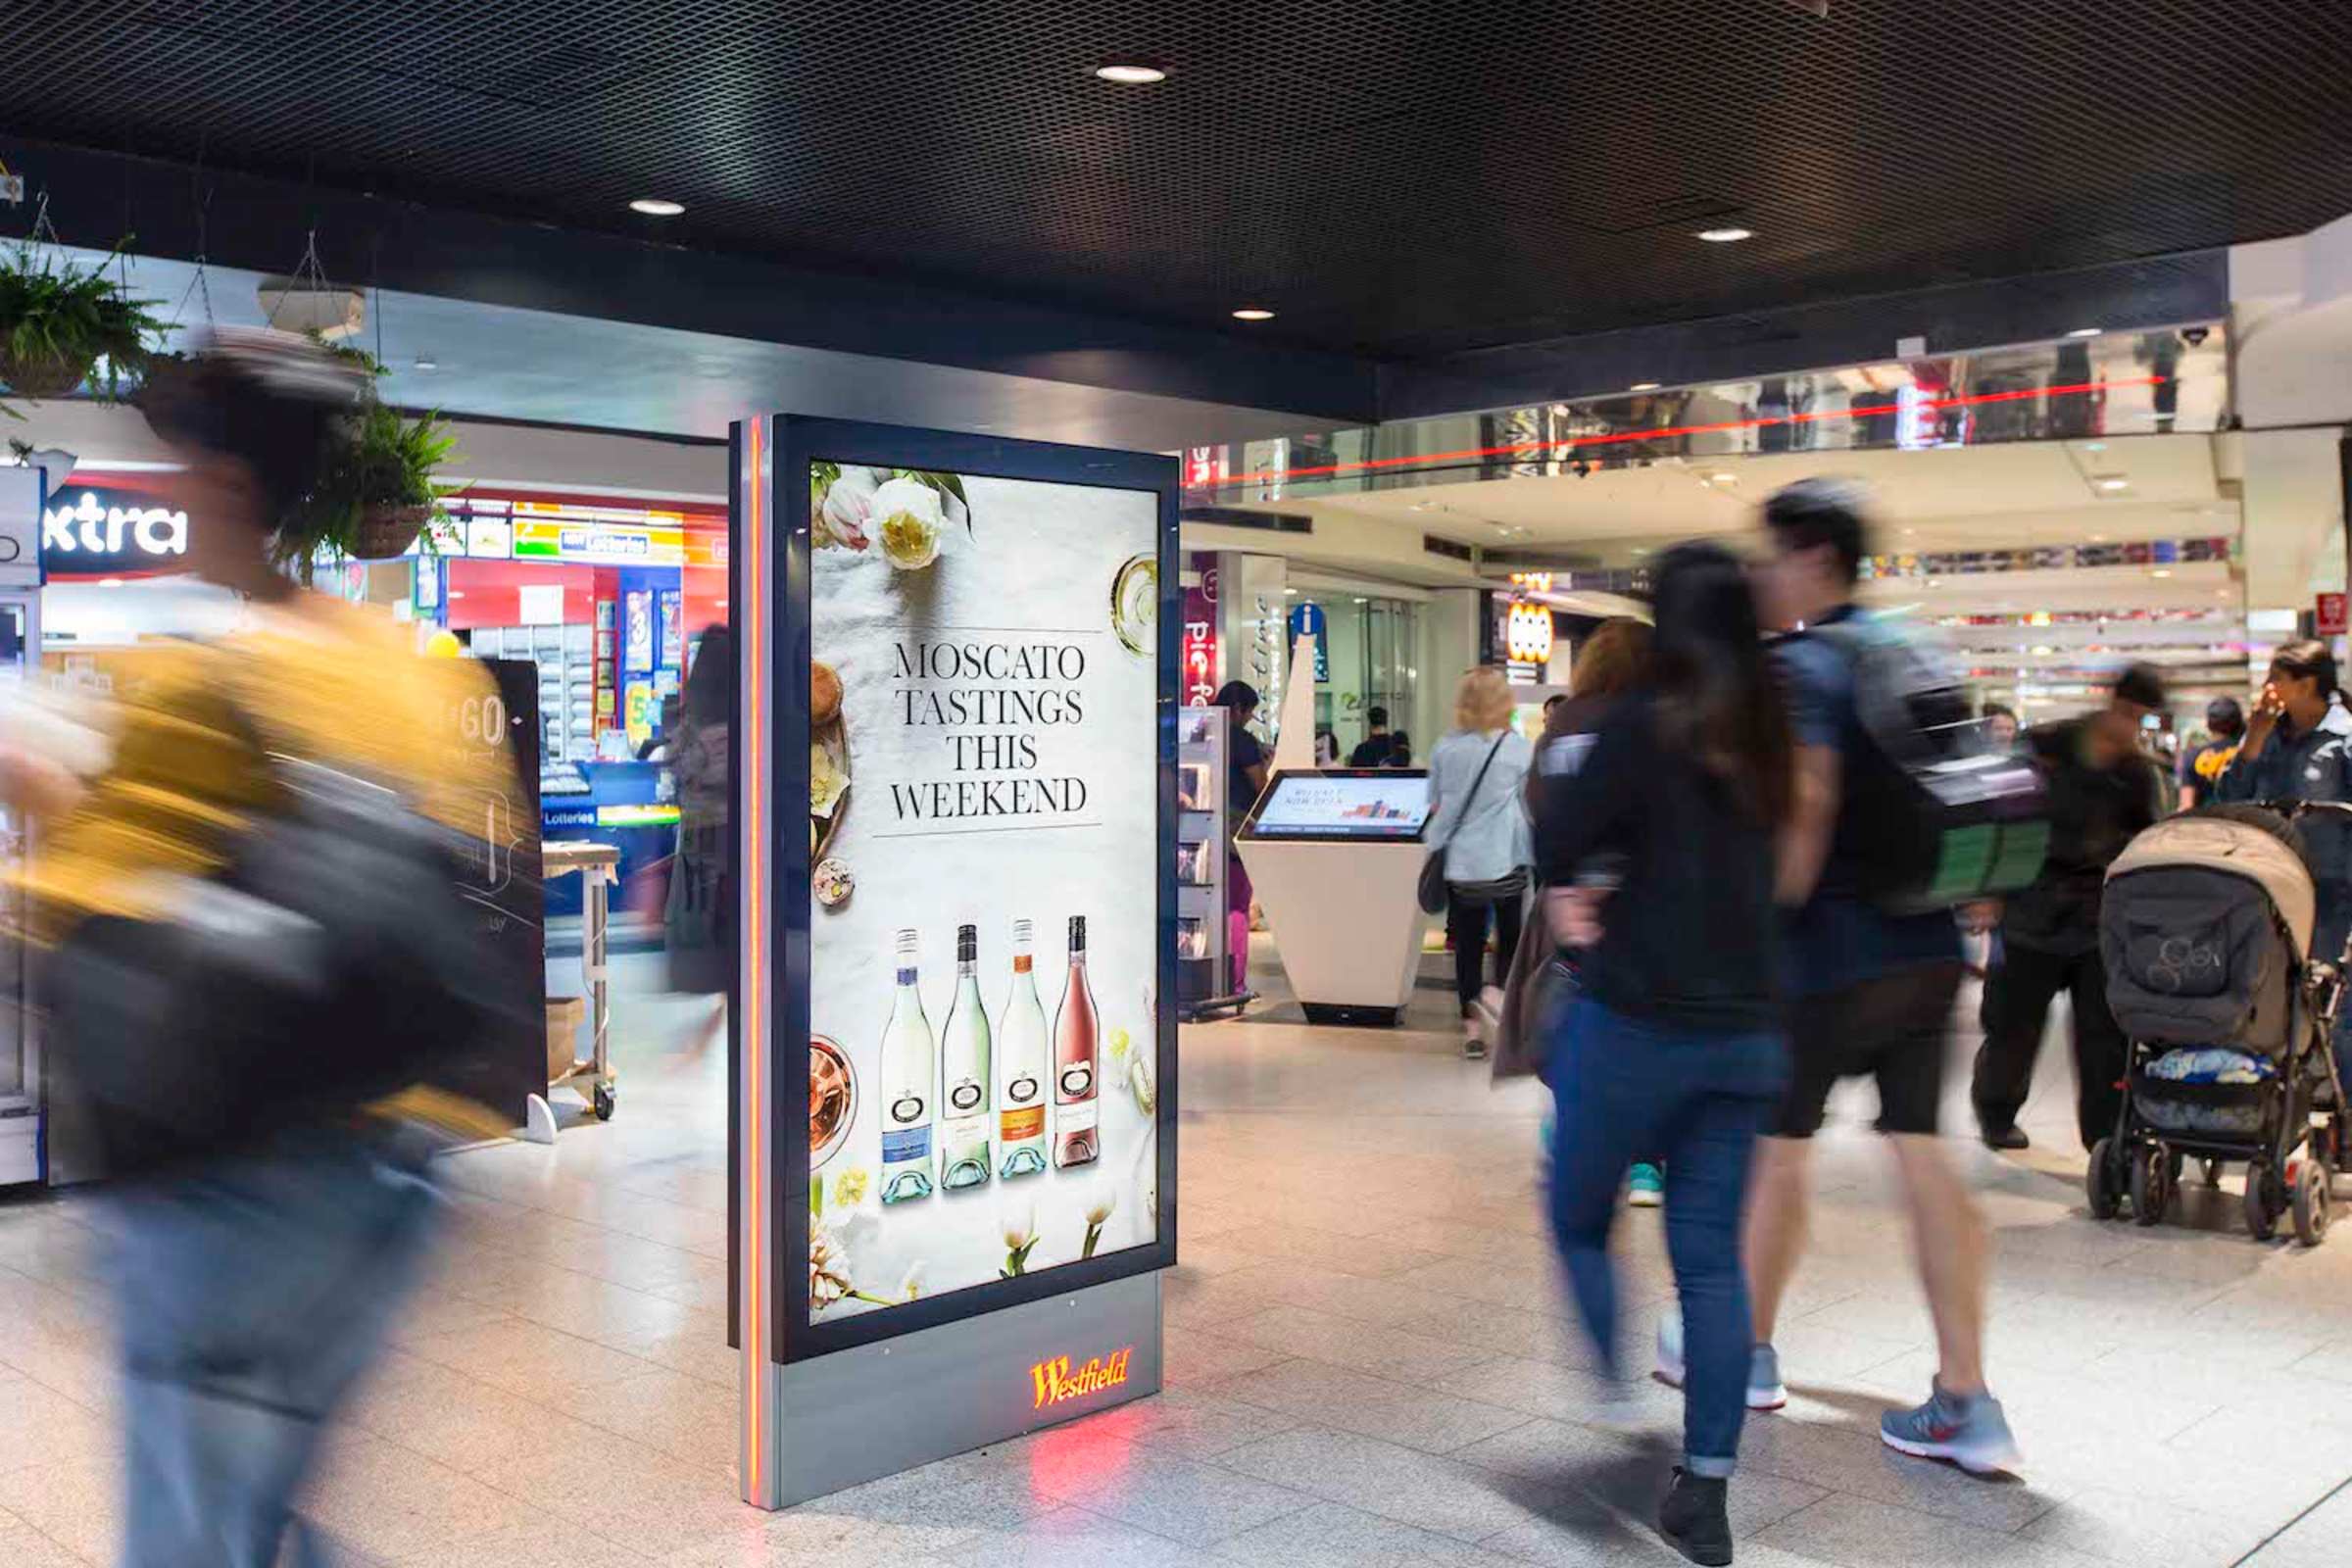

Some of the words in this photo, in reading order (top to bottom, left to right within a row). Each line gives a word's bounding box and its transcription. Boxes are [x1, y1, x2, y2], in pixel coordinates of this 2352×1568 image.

[893, 642, 1085, 681] MOSCATO
[1186, 621, 1215, 675] pie
[895, 689, 1083, 725] TASTINGS
[946, 734, 1038, 771] THIS
[545, 812, 595, 824] Lotteries
[891, 777, 1087, 820] WEEKEND
[1030, 1348, 1131, 1409] Westfield
